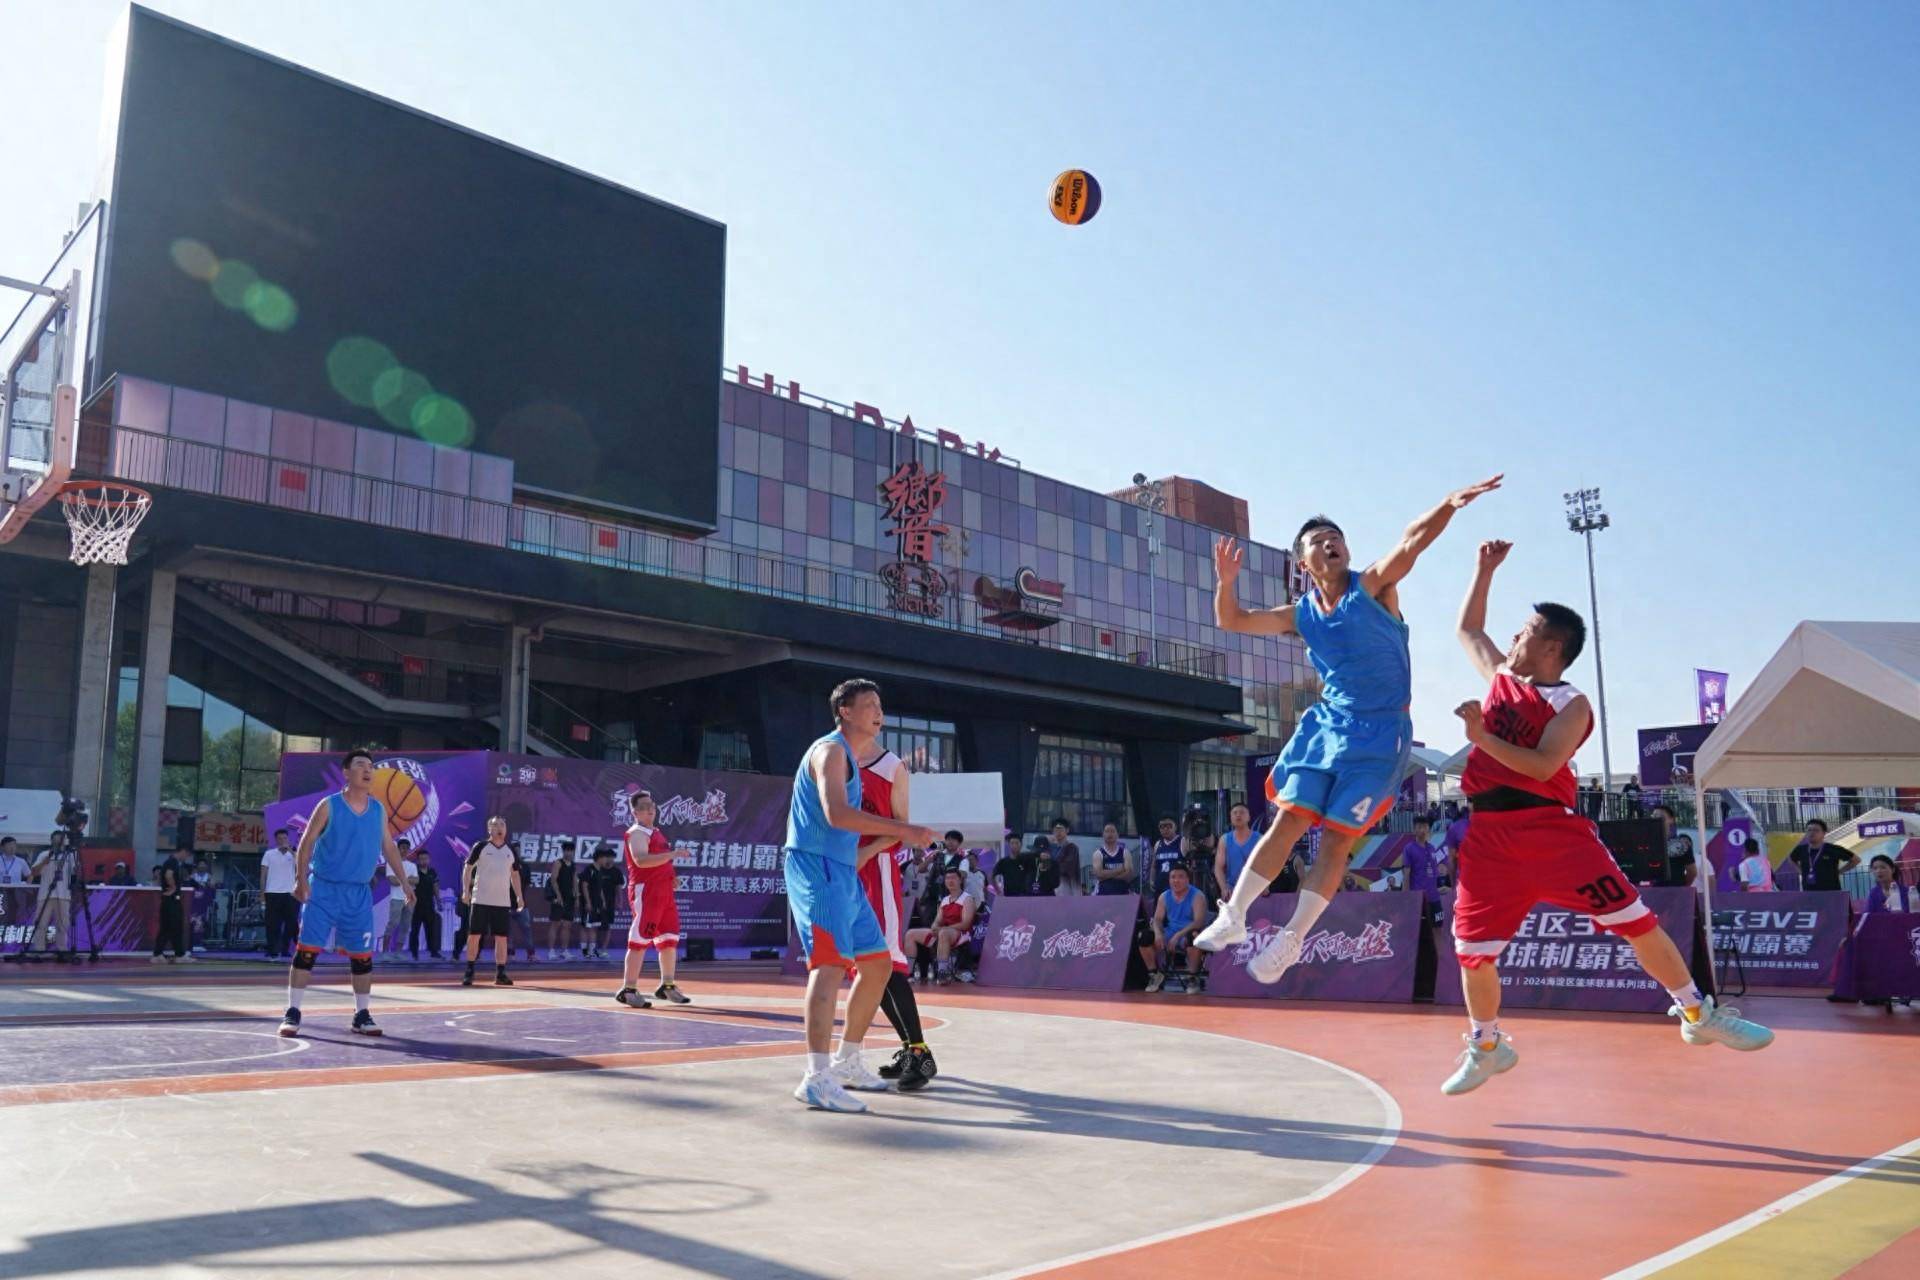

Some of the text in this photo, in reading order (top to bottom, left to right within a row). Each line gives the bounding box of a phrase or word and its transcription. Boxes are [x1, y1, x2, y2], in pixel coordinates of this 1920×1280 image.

[1069, 178, 1083, 215] Wilson
[1350, 796, 1373, 823] 4
[1576, 875, 1628, 910] 30
[362, 932, 372, 948] 7
